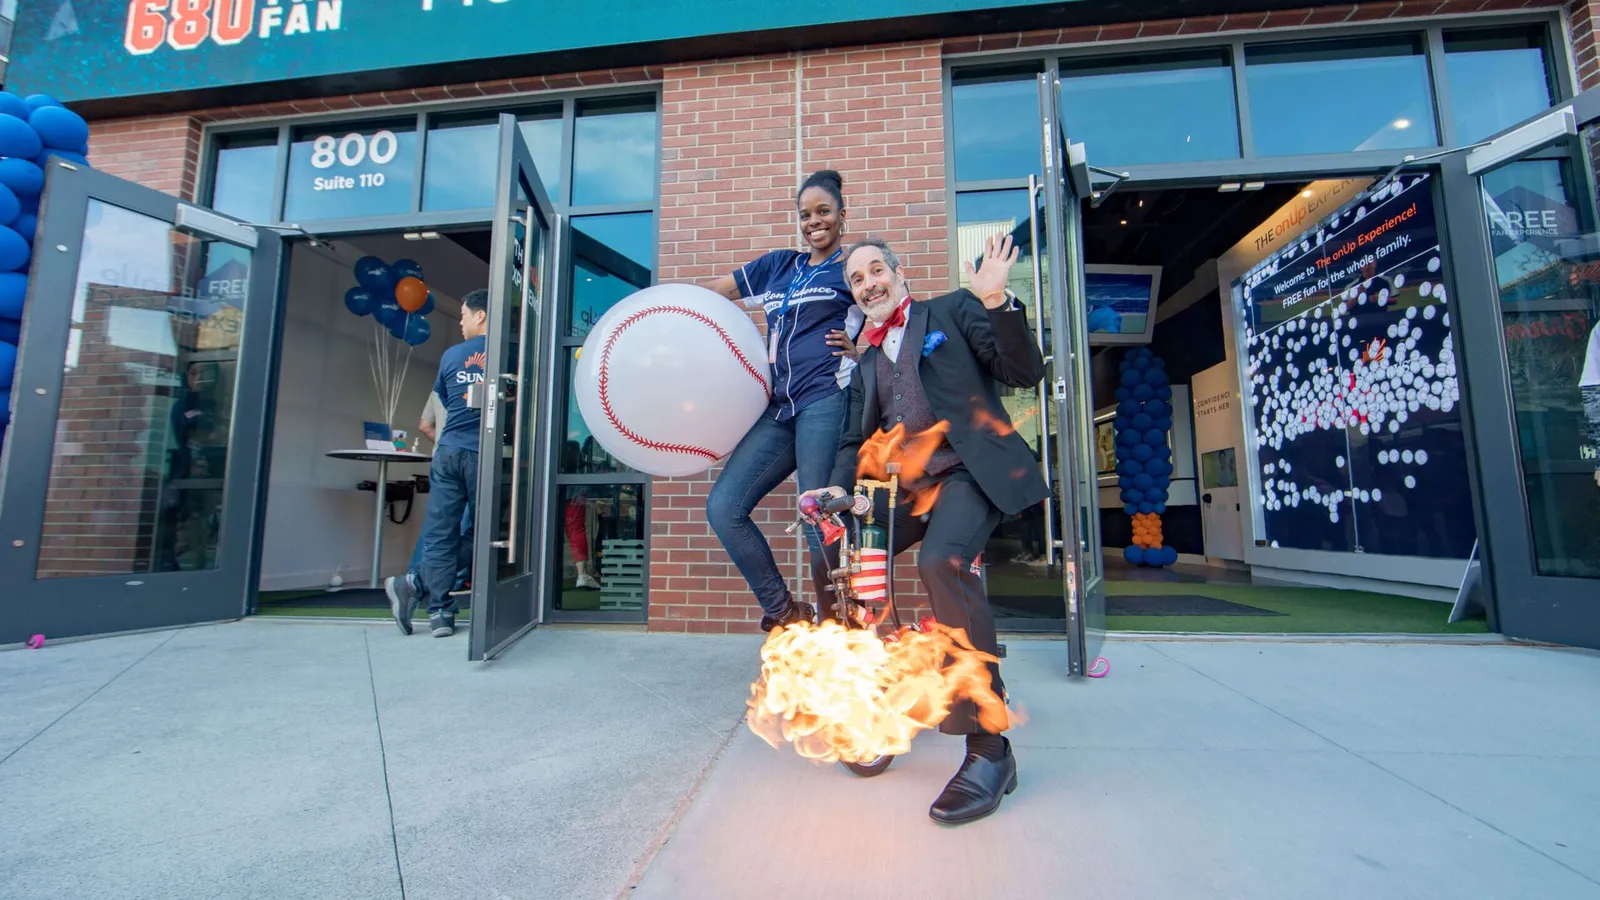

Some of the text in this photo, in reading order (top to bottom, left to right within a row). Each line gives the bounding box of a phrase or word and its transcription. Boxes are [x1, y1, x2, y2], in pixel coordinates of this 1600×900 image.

[124, 0, 254, 55] 680
[258, 0, 343, 38] FAN
[311, 130, 397, 168] 800
[313, 172, 385, 190] Suite 110
[1254, 179, 1354, 251] THE onUp EXPER
[1489, 210, 1558, 229] FREE
[1274, 202, 1417, 295] Welcome to The onUp Experience!
[1282, 233, 1412, 309] FREE fun for the whole family.
